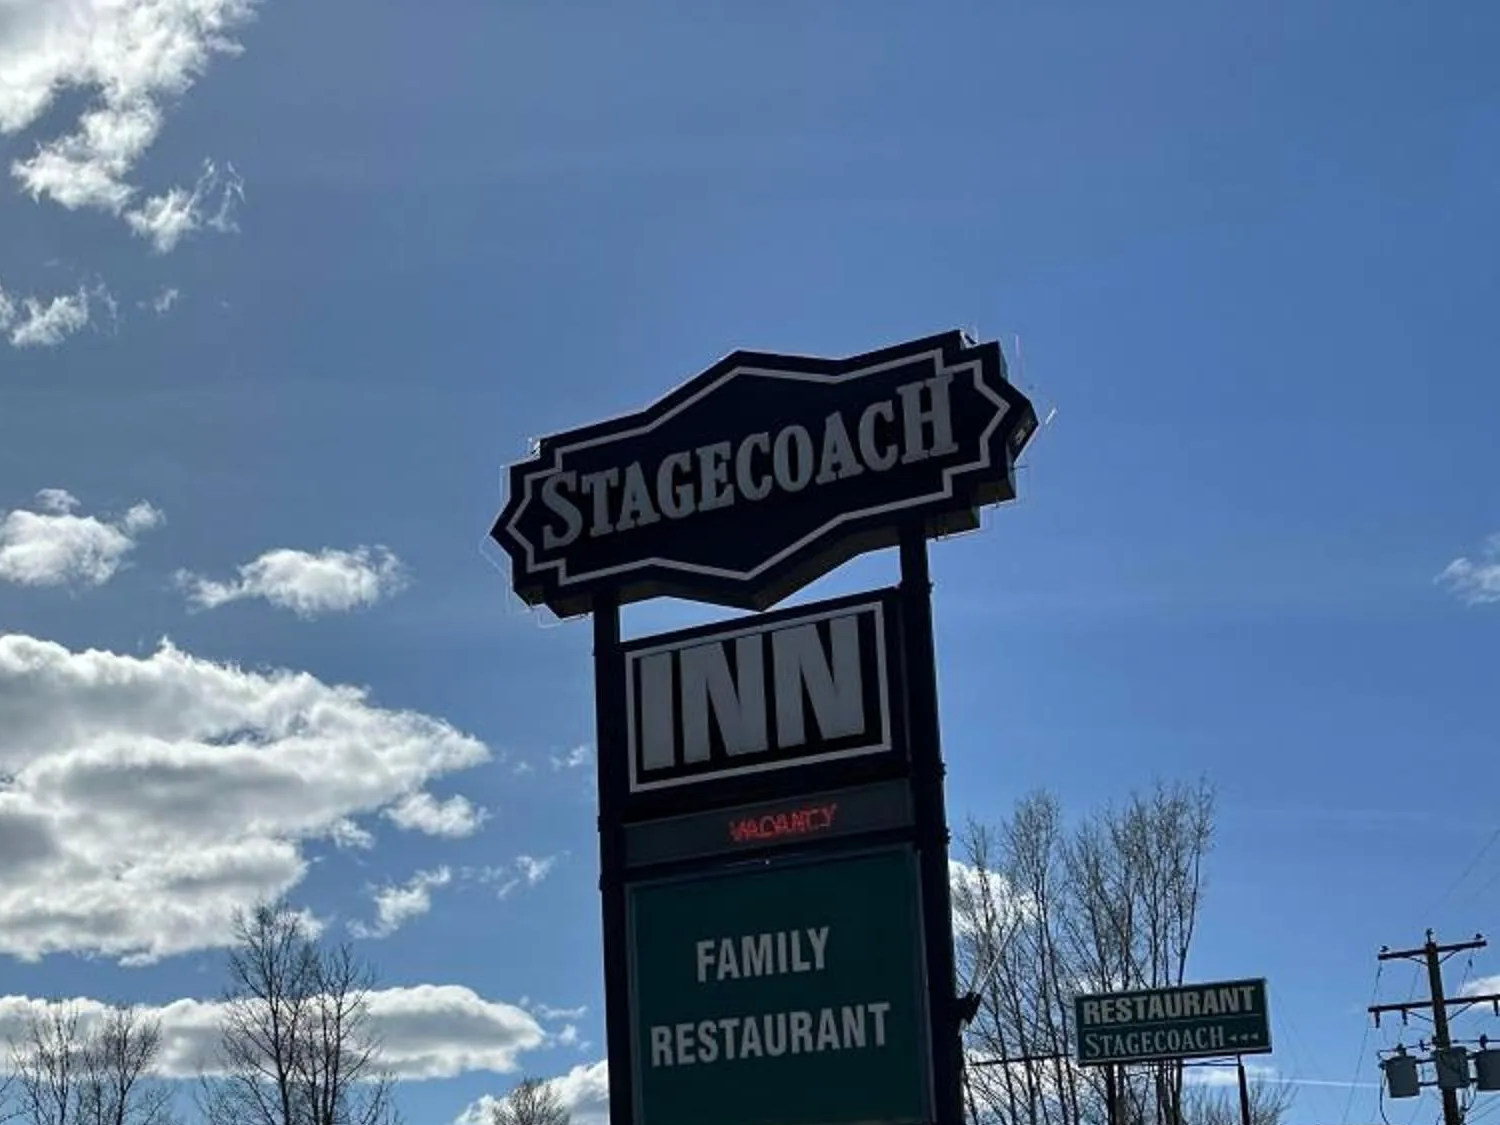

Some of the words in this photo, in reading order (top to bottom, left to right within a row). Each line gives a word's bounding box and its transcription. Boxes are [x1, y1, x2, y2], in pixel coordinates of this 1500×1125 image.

[541, 376, 959, 550] STAGECOACH
[640, 613, 866, 771] INN
[729, 803, 837, 842] VACANCY
[696, 926, 830, 983] FAMILY
[1083, 985, 1256, 1026] RESTAURANT
[651, 1002, 891, 1068] RESTAURANT
[1085, 1025, 1225, 1058] STAGECOACH
